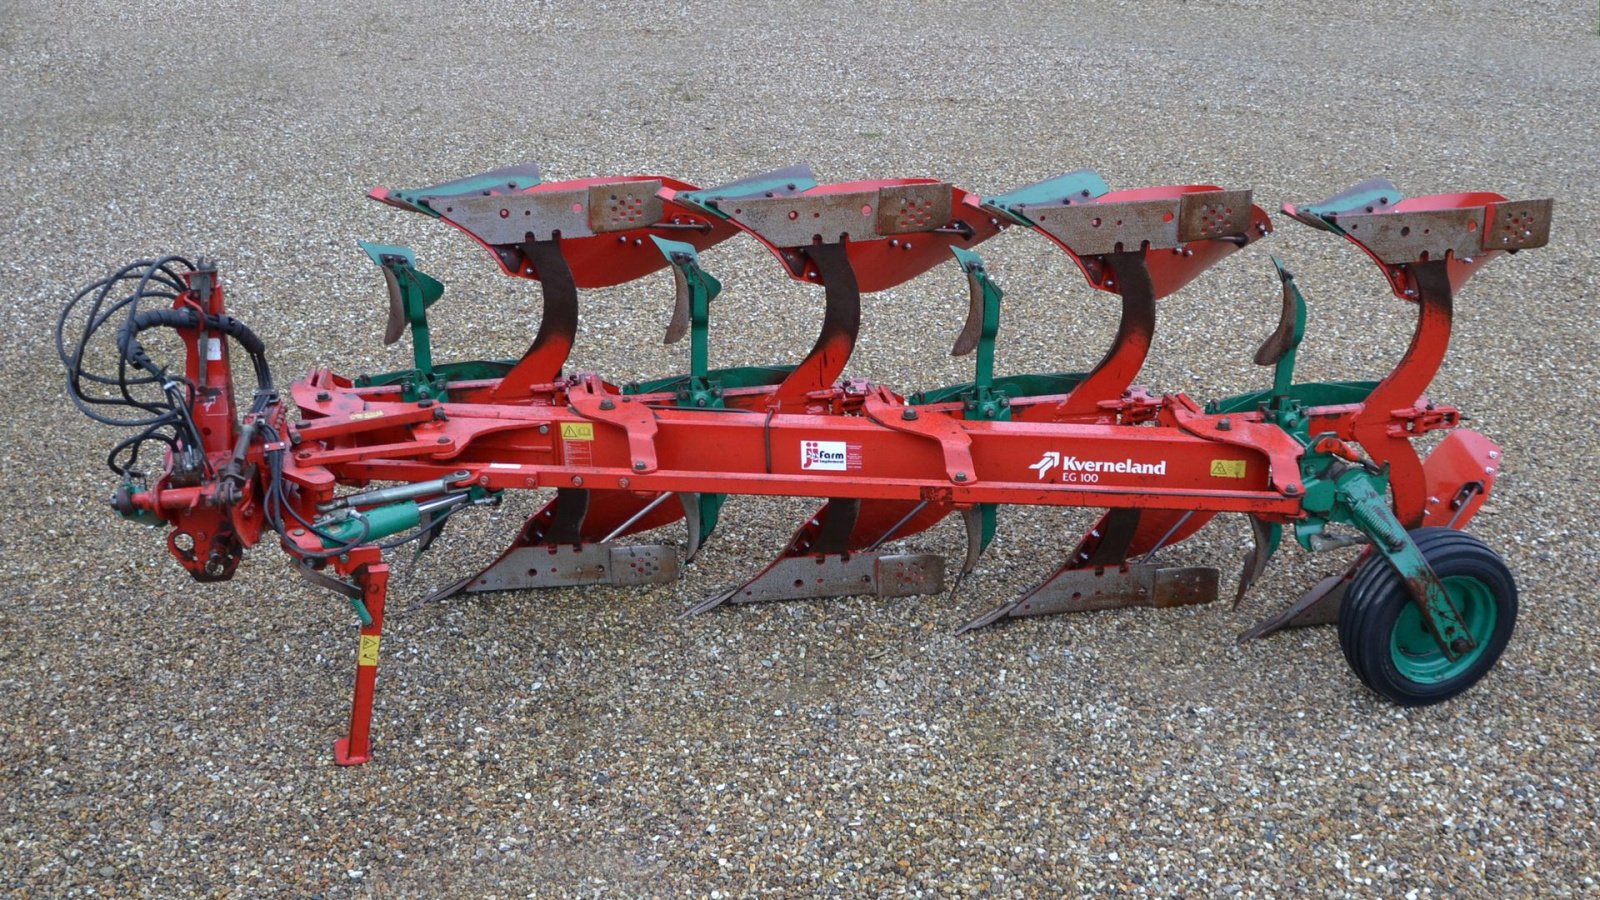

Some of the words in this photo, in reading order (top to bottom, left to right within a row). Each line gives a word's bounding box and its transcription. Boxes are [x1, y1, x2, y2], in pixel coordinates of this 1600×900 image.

[1063, 456, 1167, 475] Kverneland
[1062, 472, 1077, 482] EG
[1080, 473, 1099, 483] 100
